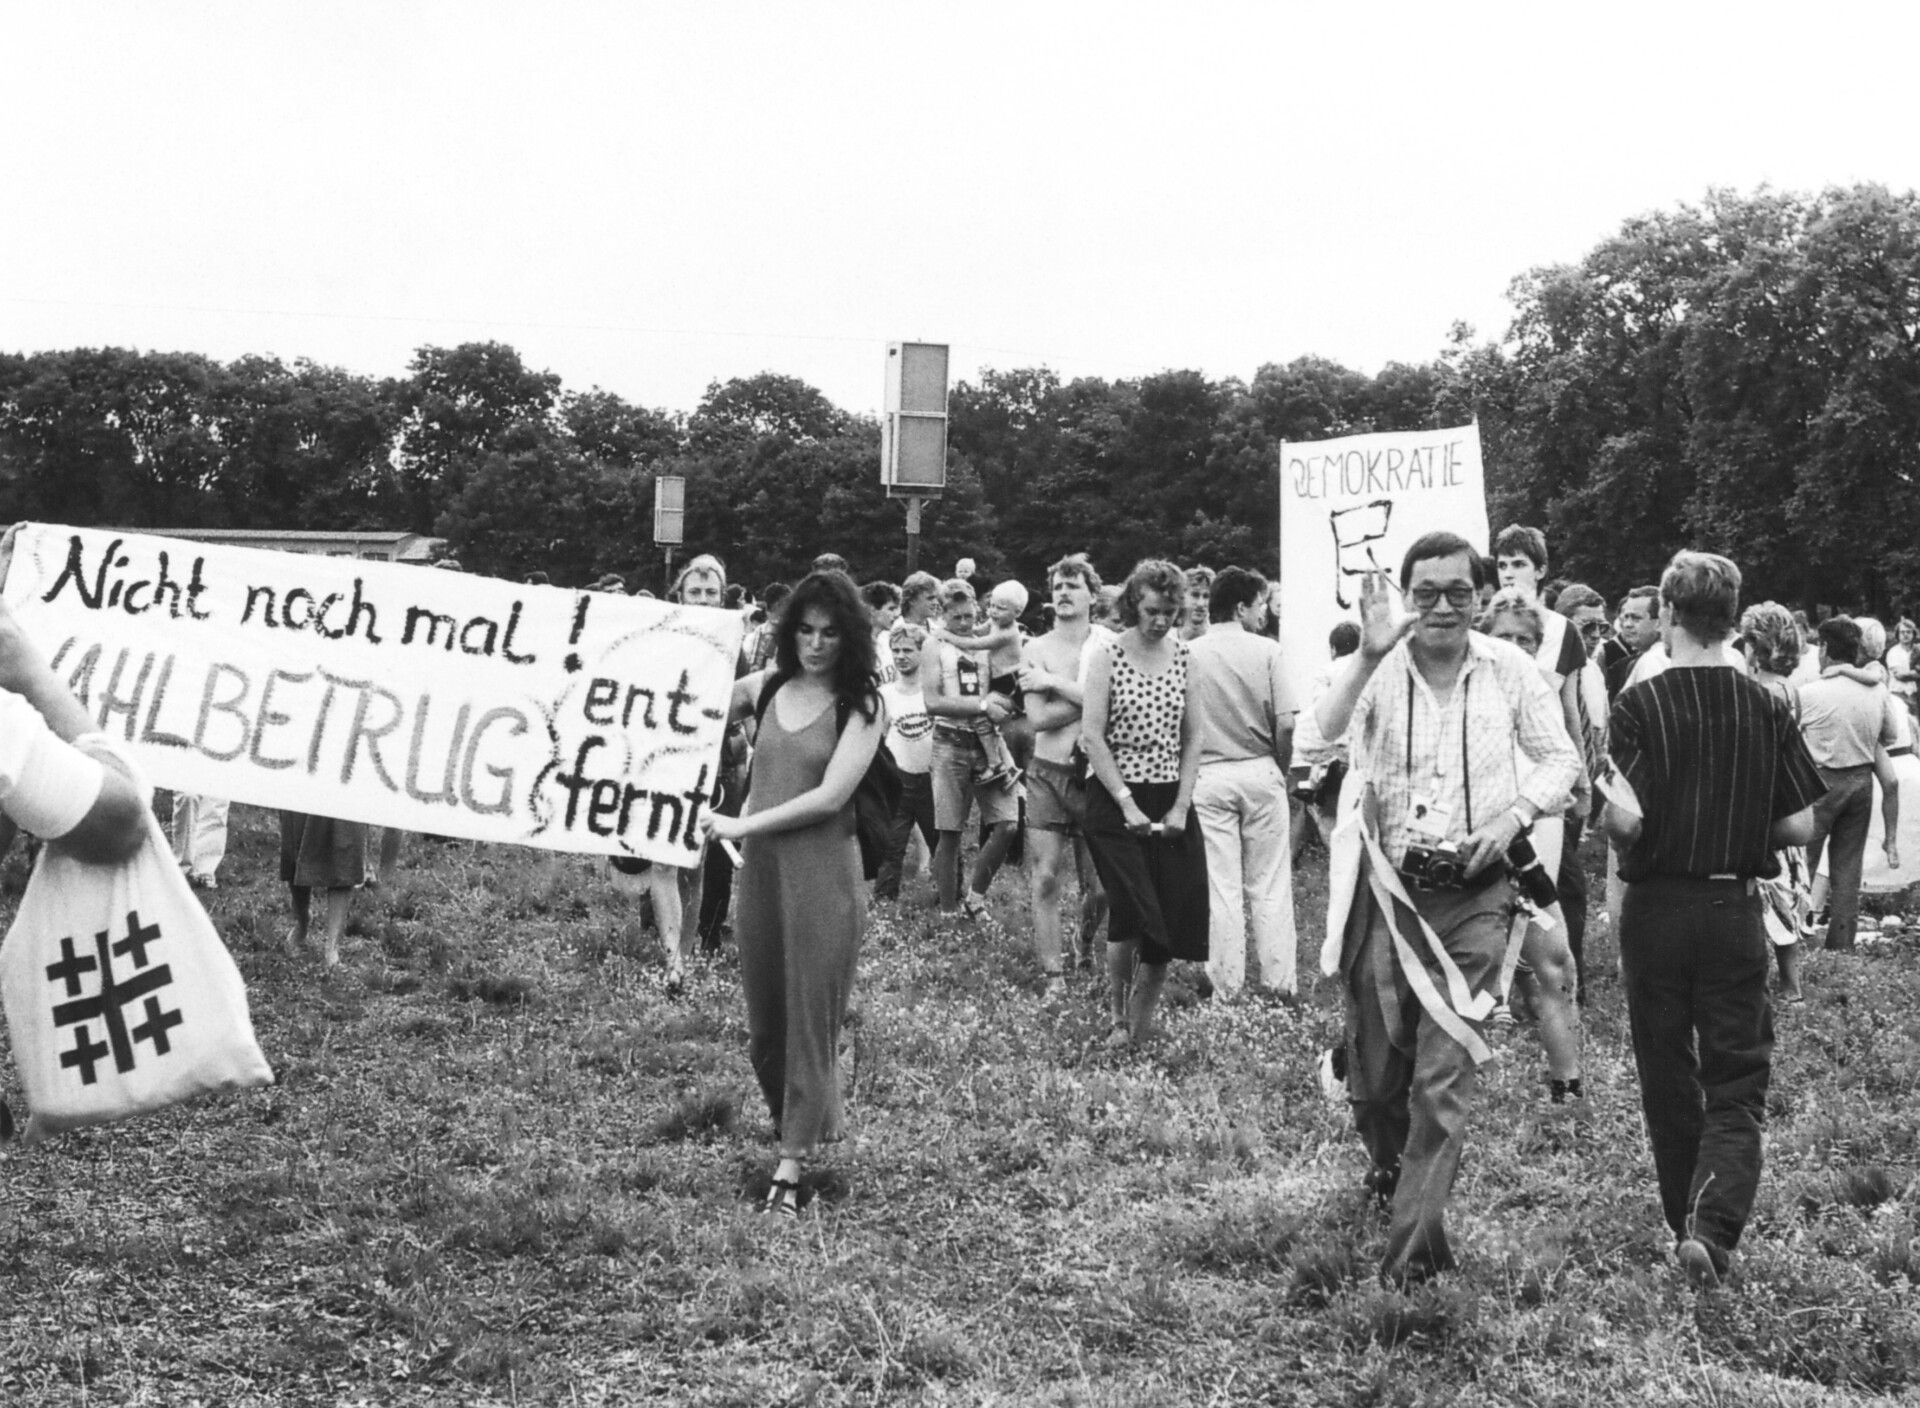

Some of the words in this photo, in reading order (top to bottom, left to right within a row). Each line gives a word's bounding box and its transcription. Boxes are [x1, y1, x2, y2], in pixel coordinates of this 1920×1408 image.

[1289, 441, 1464, 499] DEMOKRATIE
[40, 534, 212, 620] Nicht
[240, 577, 382, 640] noch
[51, 636, 528, 816] AHLBETRUG
[583, 668, 725, 735] ent-
[555, 735, 710, 851] fernt
